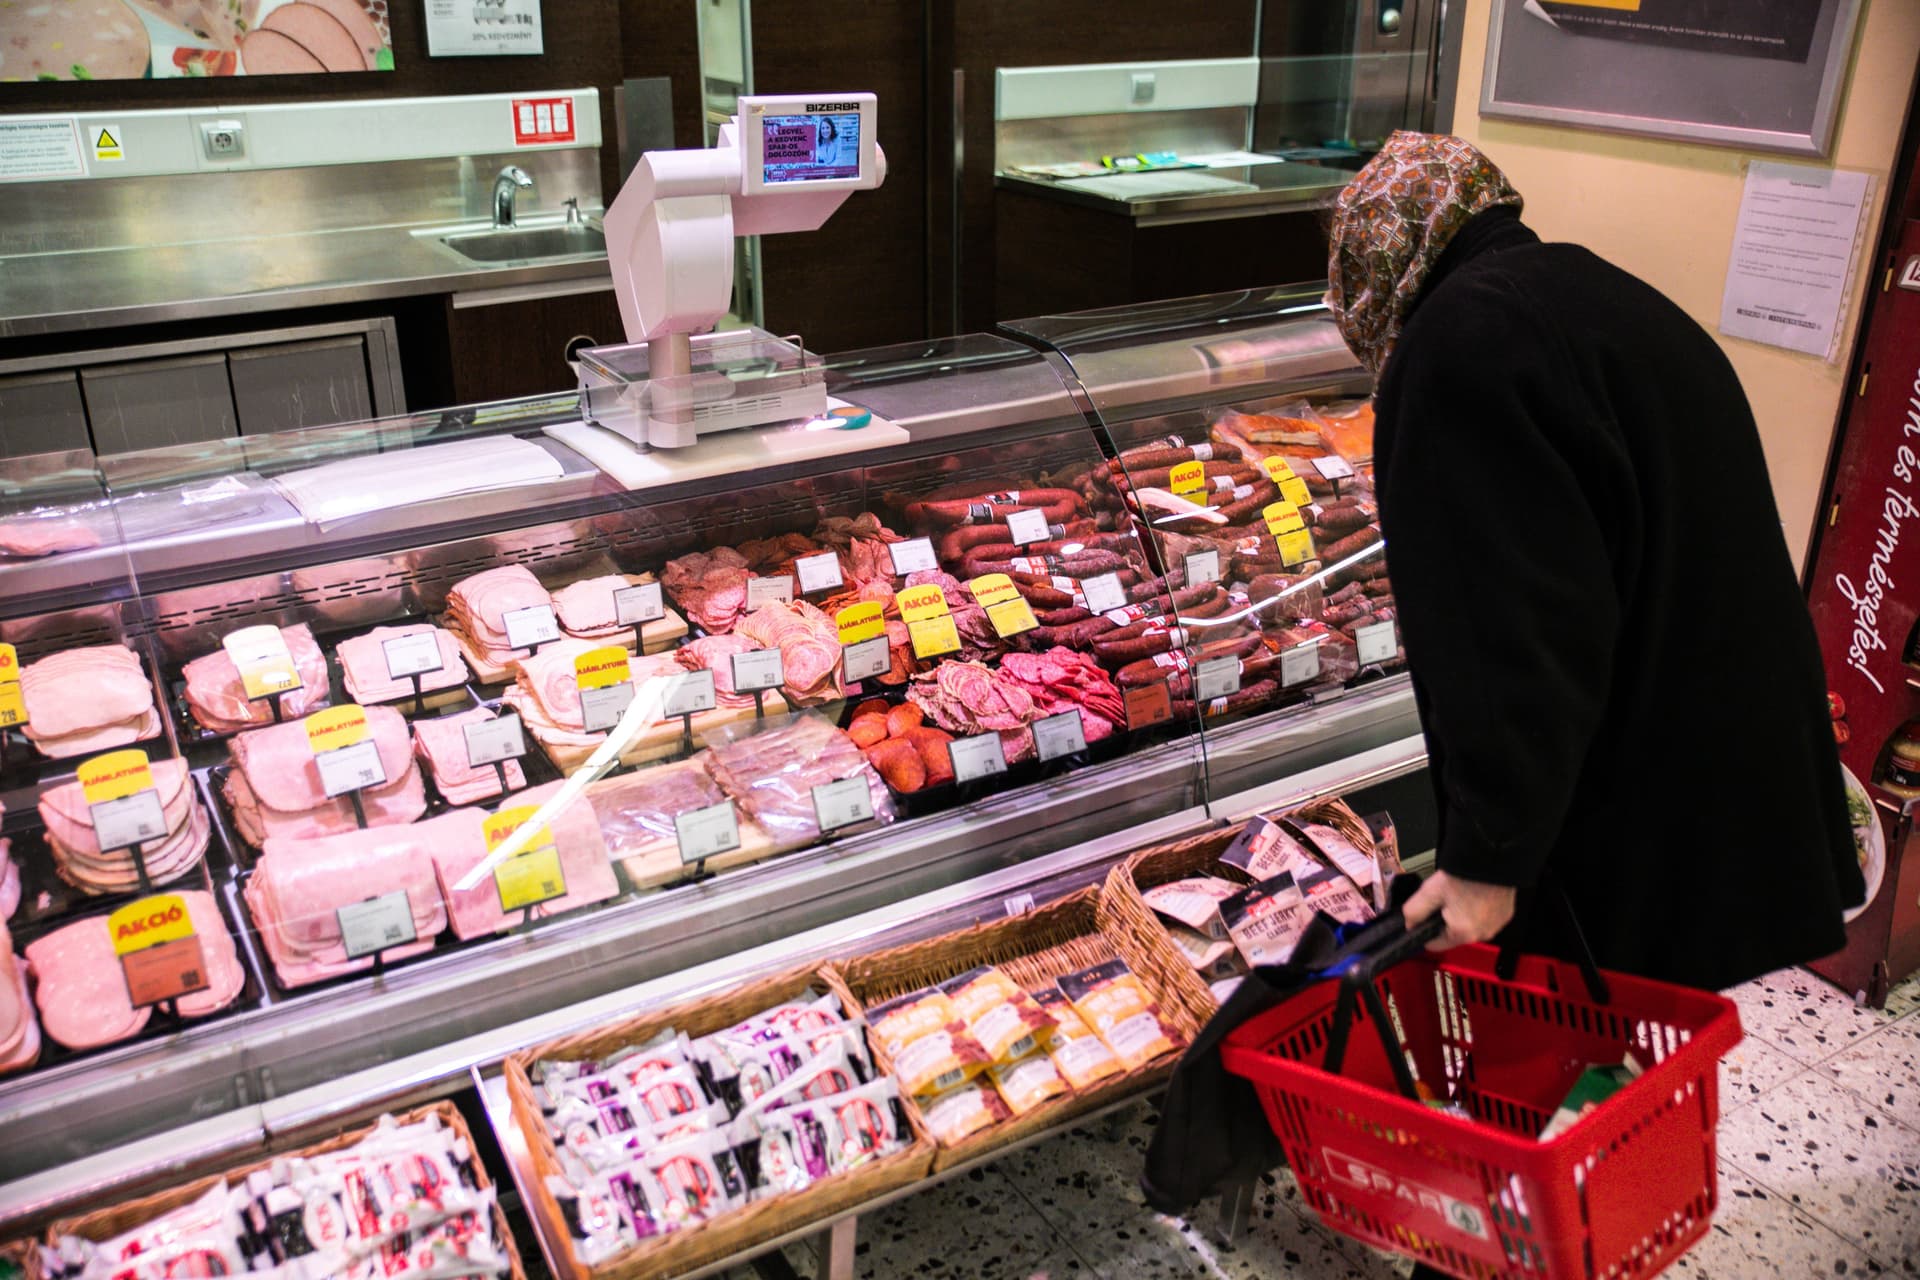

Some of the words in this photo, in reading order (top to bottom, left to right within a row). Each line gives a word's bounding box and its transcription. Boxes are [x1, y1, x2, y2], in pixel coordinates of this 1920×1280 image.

[806, 102, 860, 112] BIZERBA
[775, 135, 808, 143] KEDVENC
[1173, 468, 1201, 484] AKCIÓ
[1835, 487, 1920, 693] természetes!
[904, 592, 941, 610] AKCIÓ
[576, 659, 628, 675] AJÁNLATUNK
[309, 718, 365, 738] AJÁNLATUNK
[83, 765, 147, 787] AJÁNLATUNK
[1307, 897, 1331, 912] BEEF
[117, 904, 183, 940] AKCIÓ
[1242, 918, 1268, 940] BEEF
[1268, 904, 1299, 926] JERKY
[1347, 1163, 1441, 1215] SPAR
